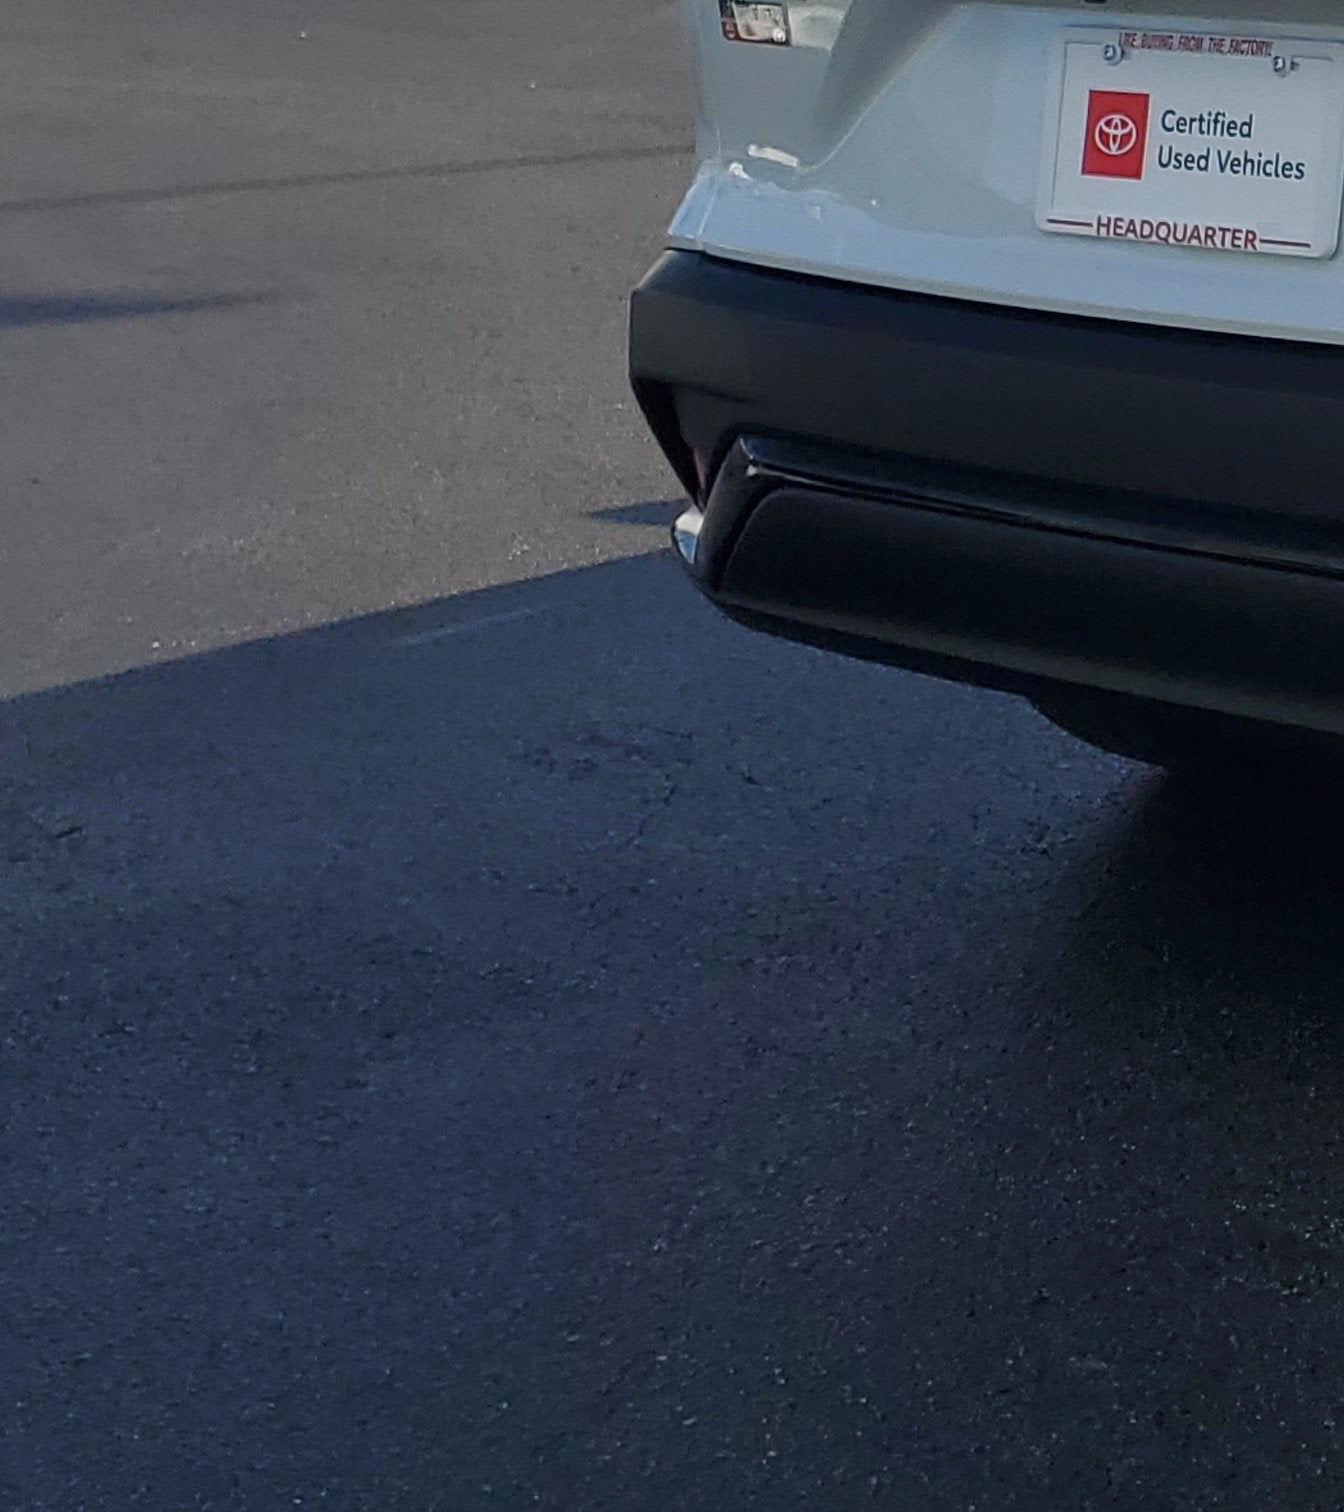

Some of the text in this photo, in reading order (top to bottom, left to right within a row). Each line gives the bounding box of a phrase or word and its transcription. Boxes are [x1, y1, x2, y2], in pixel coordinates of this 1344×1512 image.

[1178, 35, 1204, 53] FROM
[1208, 37, 1226, 54] THE
[1160, 109, 1253, 139] Certified
[1157, 145, 1306, 180] Used Vehicles
[1096, 215, 1259, 251] HEADQUARTER
